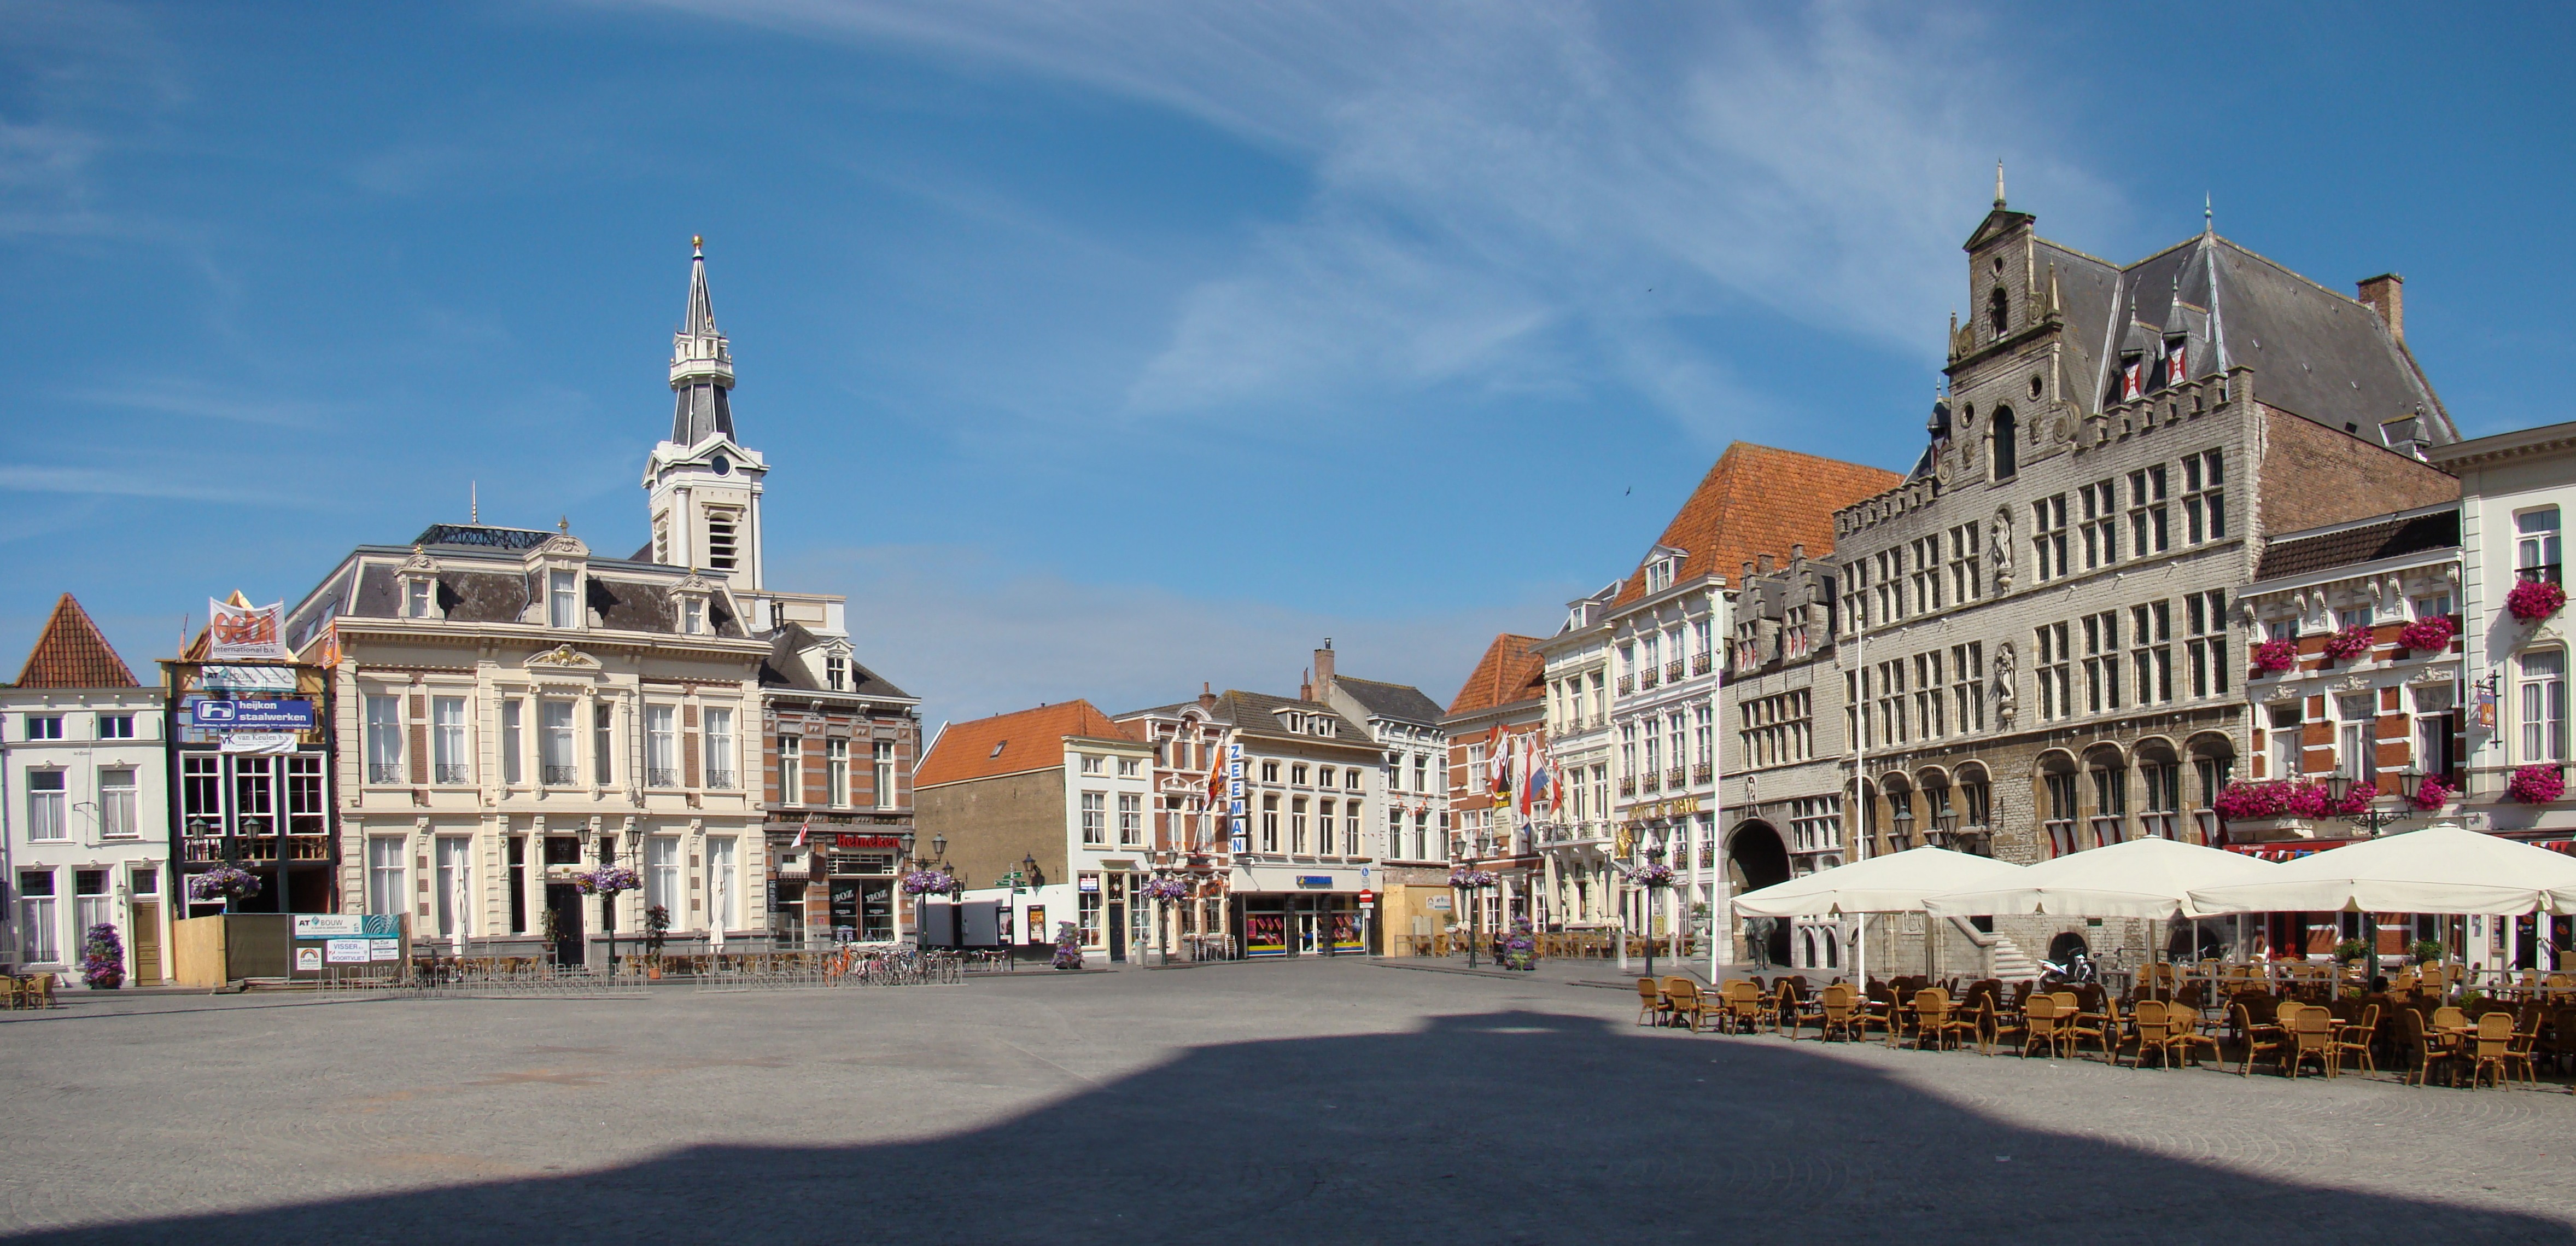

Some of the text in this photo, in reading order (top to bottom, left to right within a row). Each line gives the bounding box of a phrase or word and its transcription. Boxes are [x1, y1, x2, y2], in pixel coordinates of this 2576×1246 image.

[239, 701, 277, 711] heijkon
[240, 713, 306, 721] staalwerken
[1231, 745, 1242, 852] ZEEMAN
[837, 834, 899, 848] Heineken
[865, 889, 887, 903] BOZ
